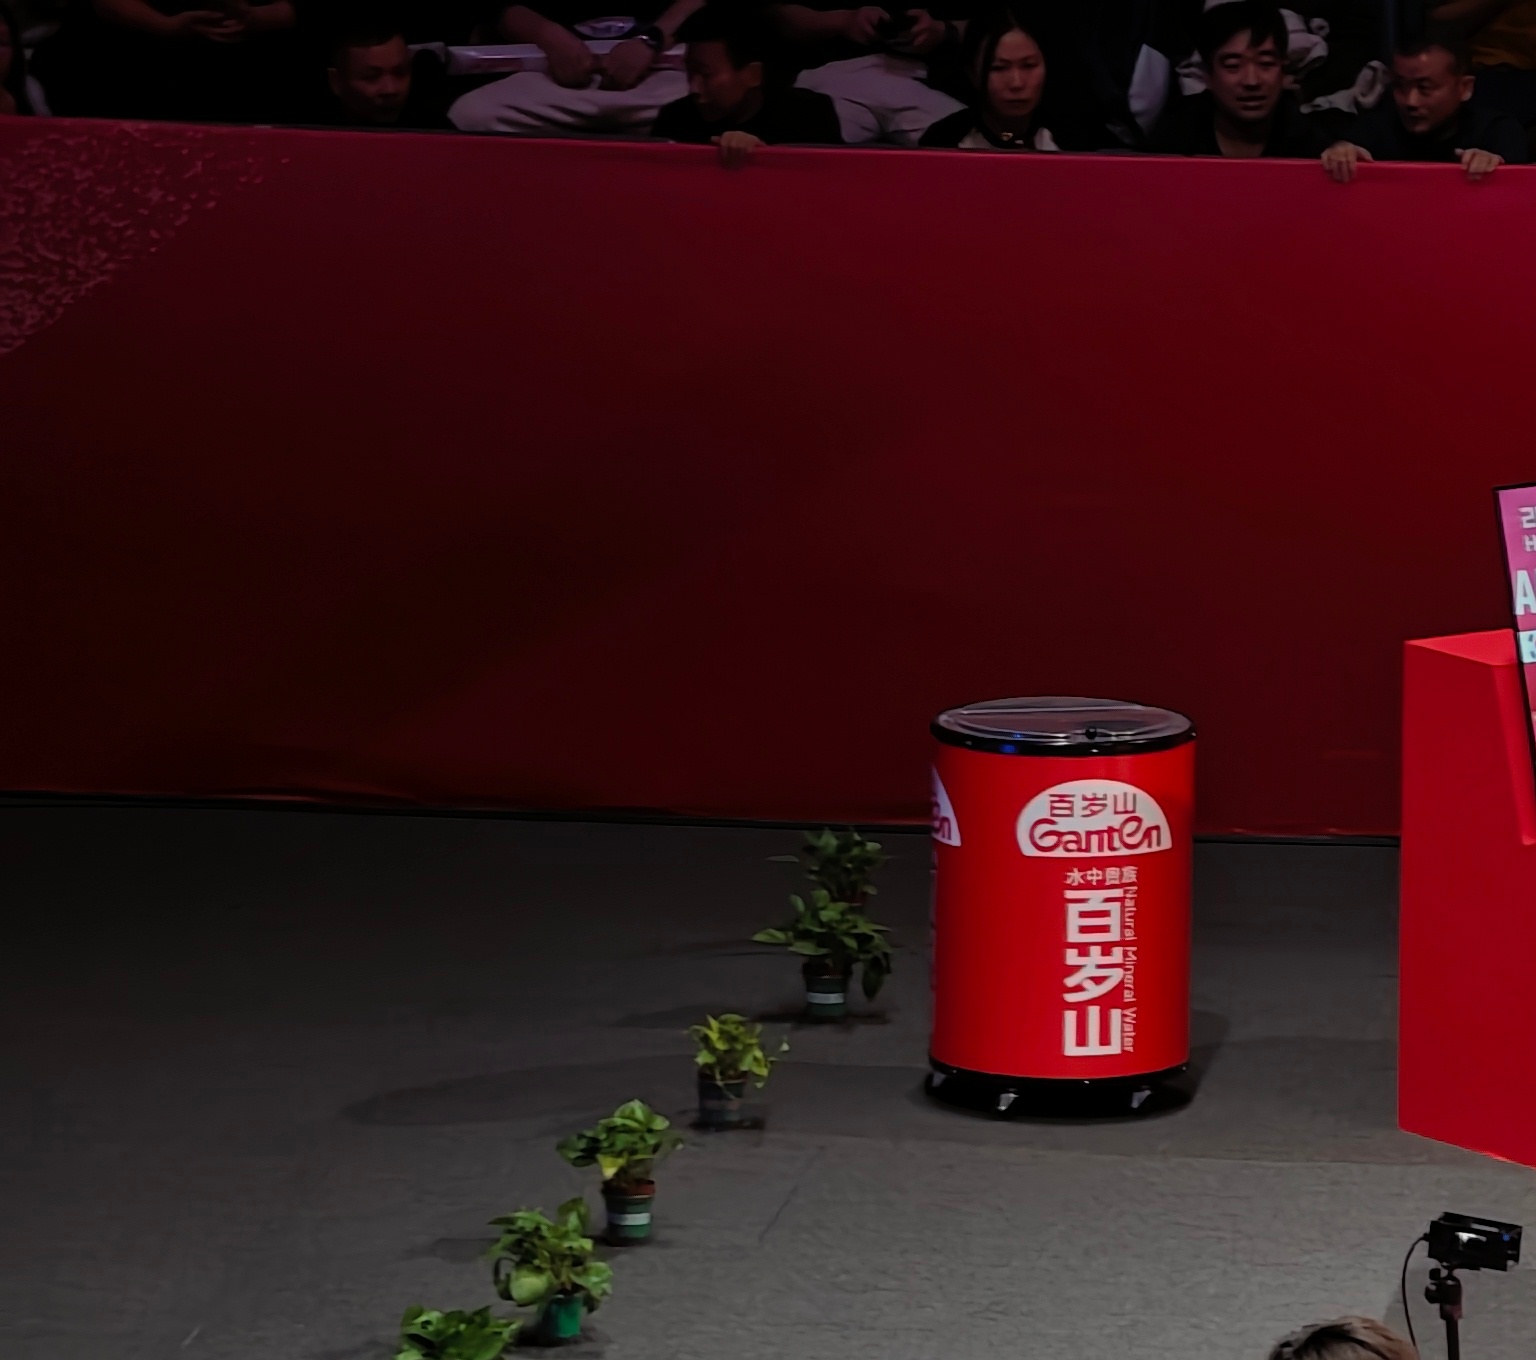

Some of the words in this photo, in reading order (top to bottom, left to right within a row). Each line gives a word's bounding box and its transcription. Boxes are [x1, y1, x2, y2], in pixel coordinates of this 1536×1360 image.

[1048, 791, 1137, 818] 百岁山
[1029, 815, 1162, 853] Ganten
[1063, 888, 1125, 1057] 百岁山
